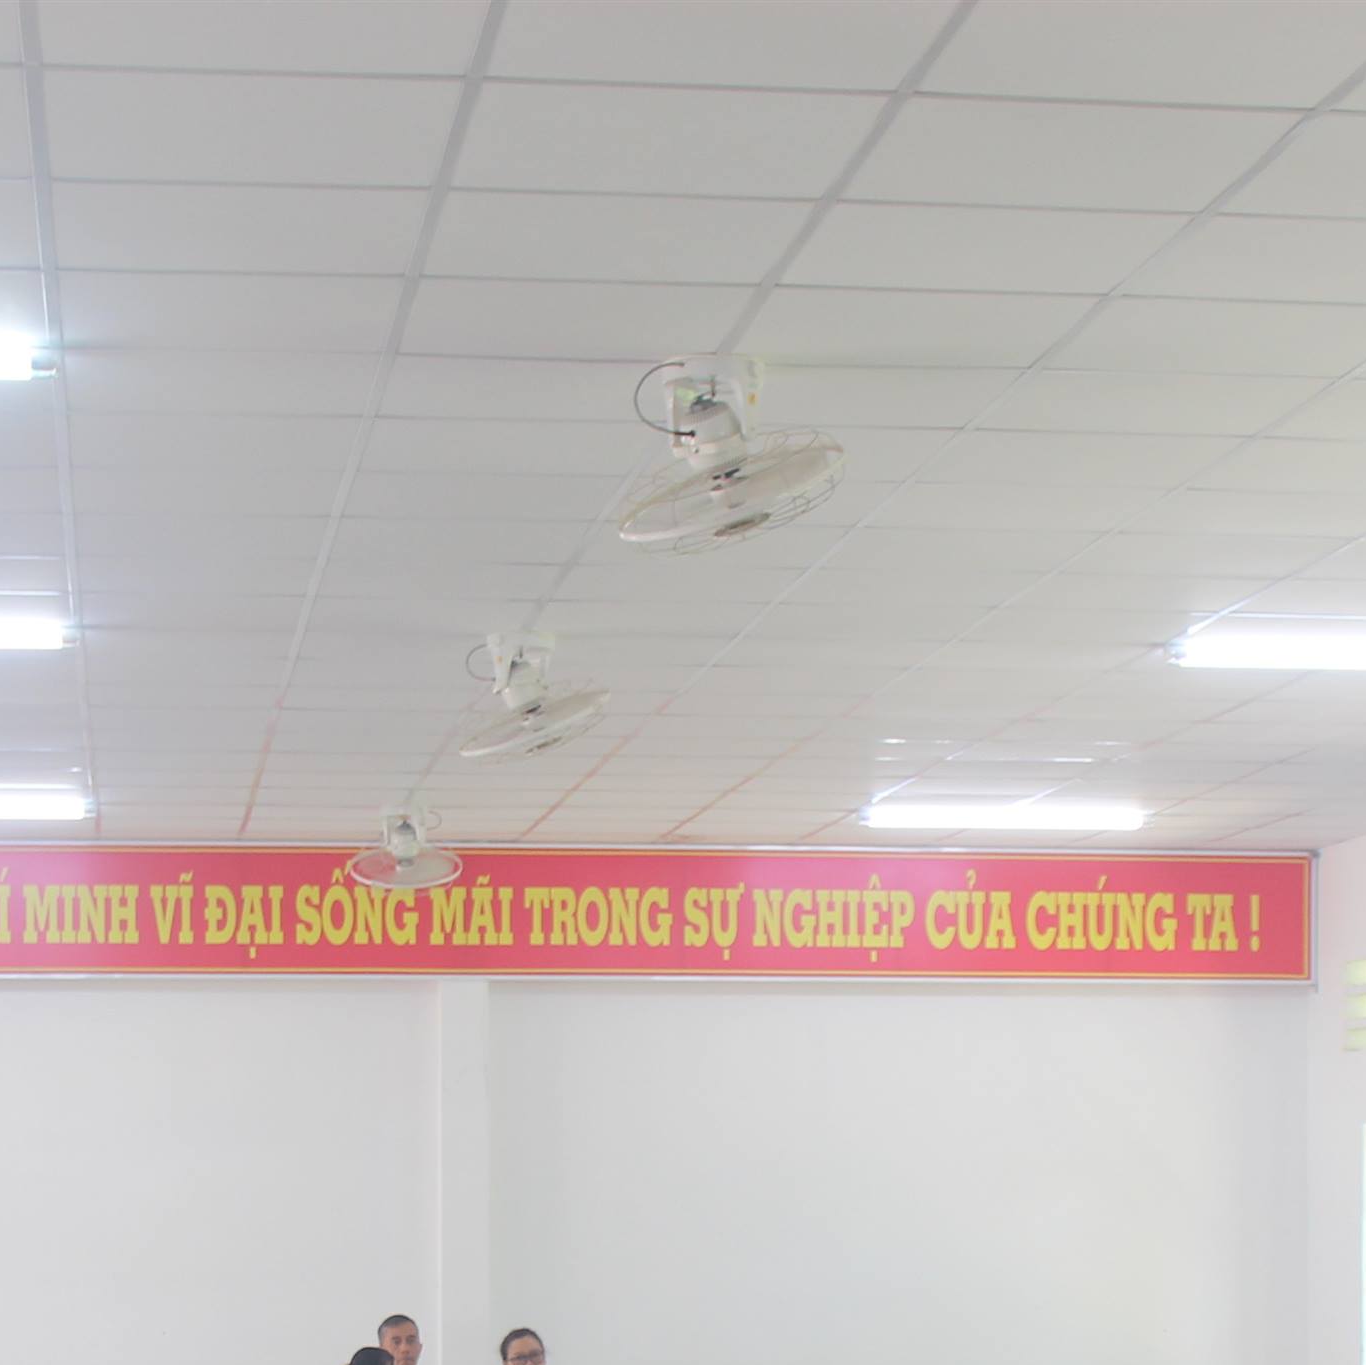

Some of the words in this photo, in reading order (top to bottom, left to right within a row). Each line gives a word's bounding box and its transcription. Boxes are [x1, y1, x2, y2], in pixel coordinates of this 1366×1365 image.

[23, 884, 140, 945] MINH
[150, 873, 195, 945] VĨ
[205, 884, 286, 958] ĐẠI
[296, 861, 420, 945] SỐNG
[430, 874, 514, 946] MÃI
[525, 886, 673, 947] TRONG
[684, 882, 745, 960] SỰ
[753, 873, 915, 961] NGHIỆP
[924, 869, 1017, 950] CỦA
[1025, 877, 1179, 952] CHÚNG
[1186, 892, 1239, 952] TA
